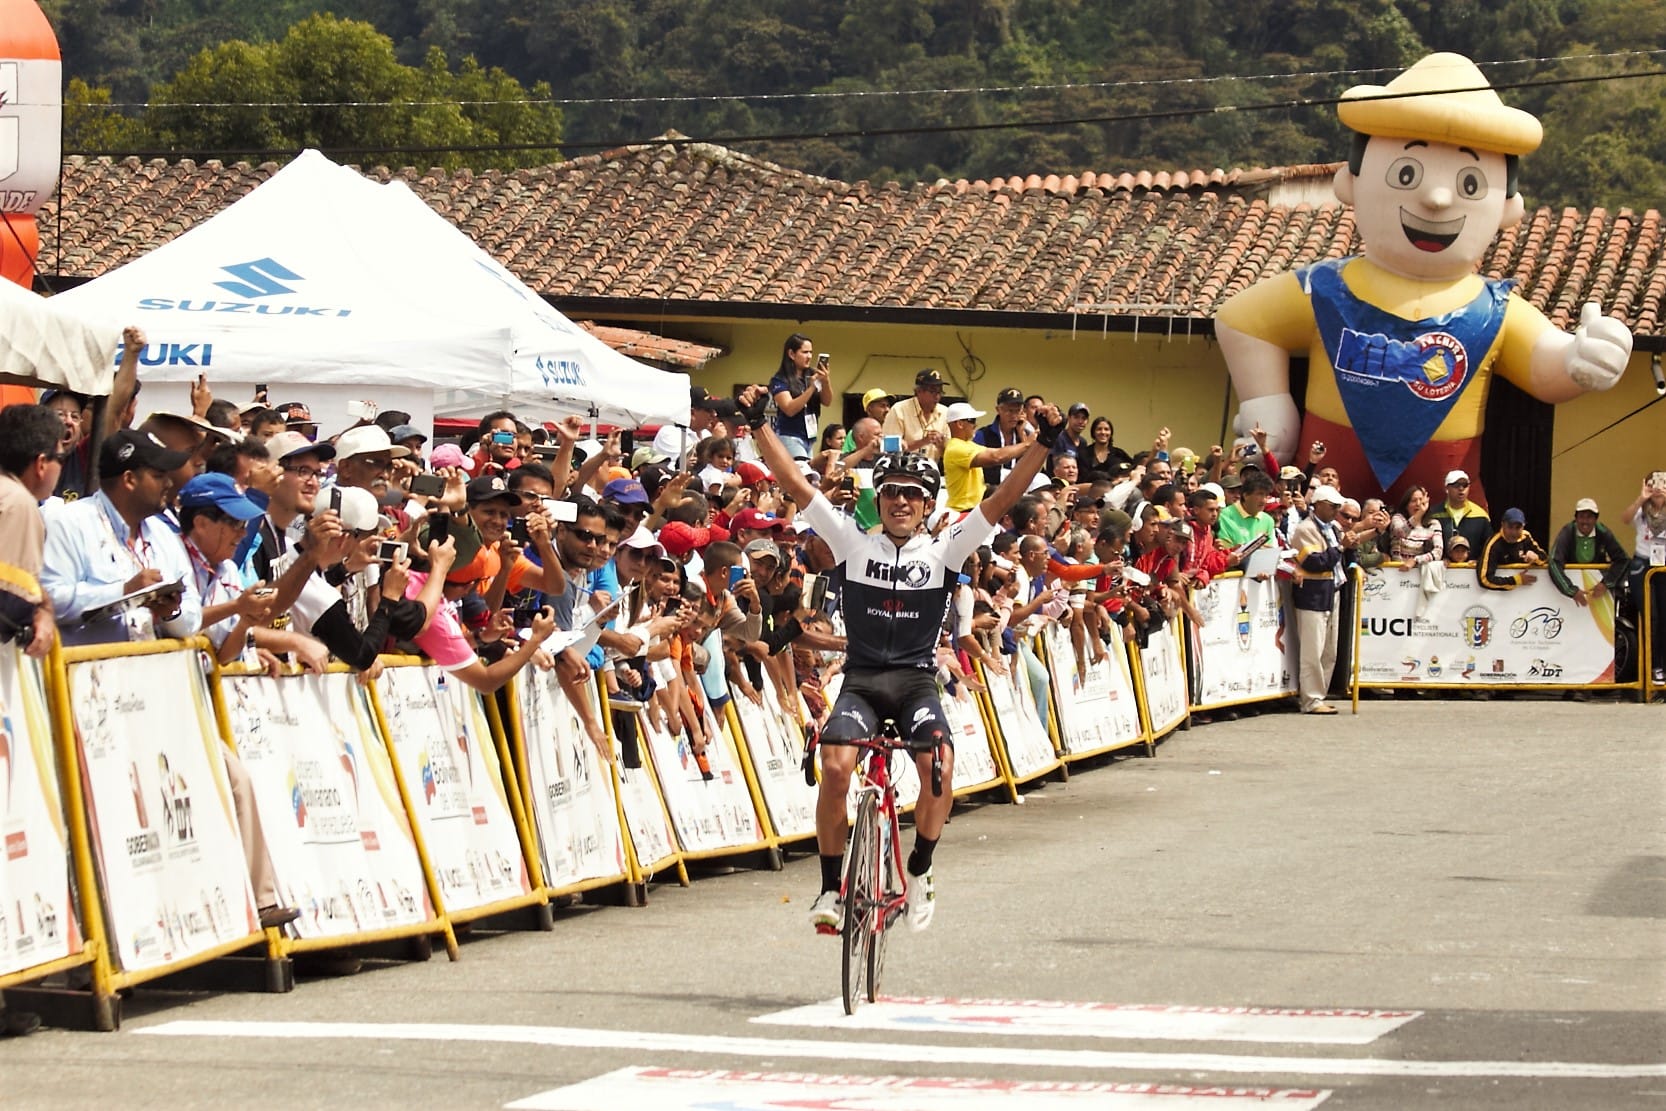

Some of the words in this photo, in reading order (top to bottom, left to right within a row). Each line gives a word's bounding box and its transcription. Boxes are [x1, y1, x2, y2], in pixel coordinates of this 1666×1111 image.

[136, 298, 352, 317] SUZUKI
[867, 607, 893, 619] ROYAL
[895, 610, 919, 619] BIKES
[1371, 617, 1412, 638] UCI
[1542, 668, 1562, 677] IDT
